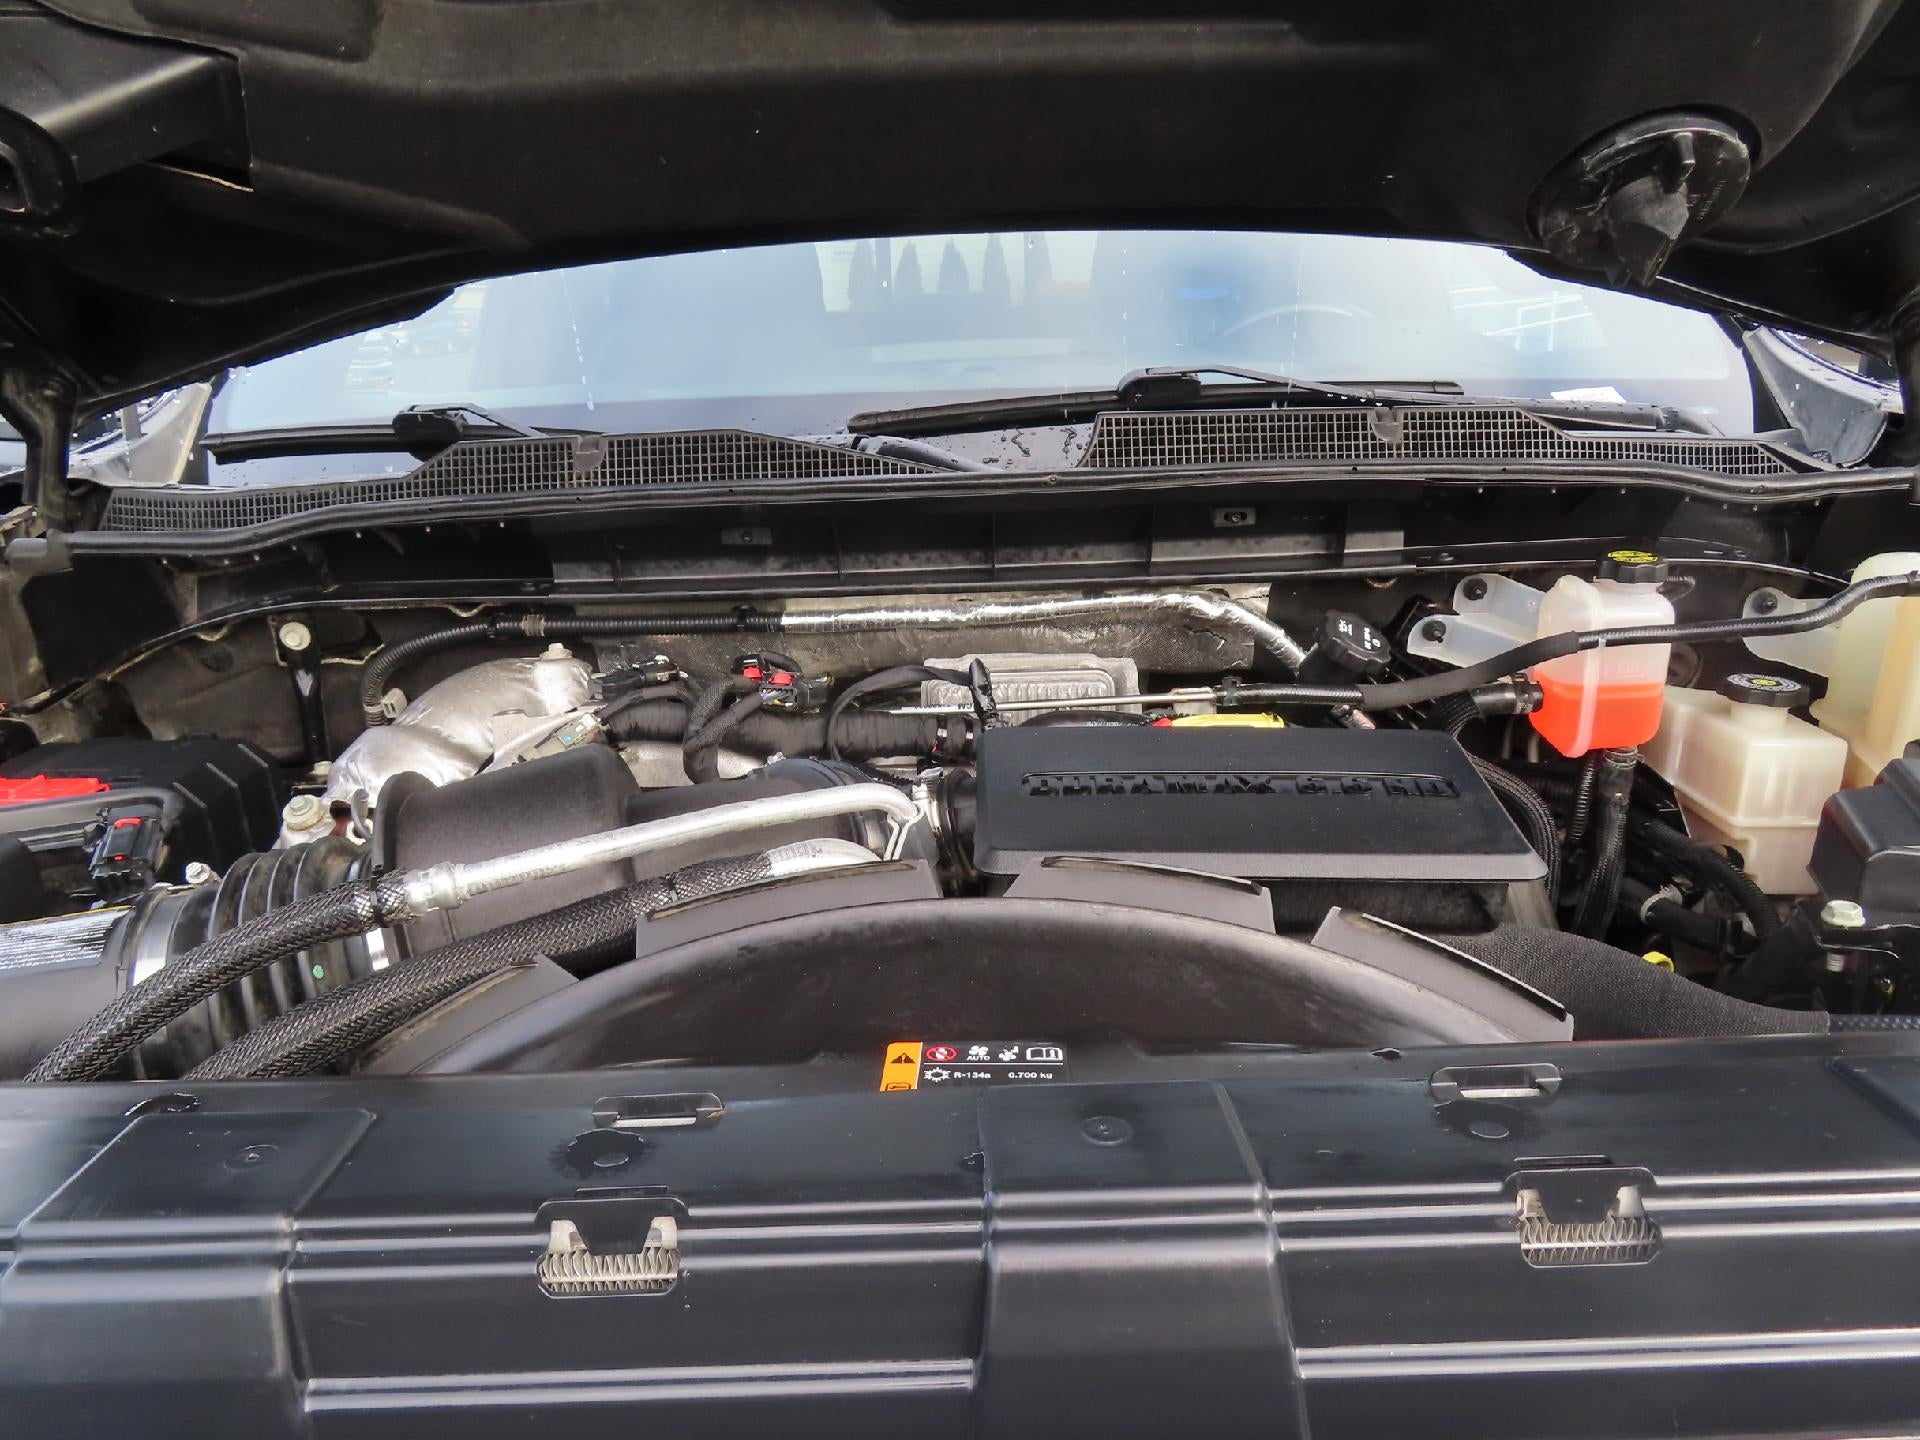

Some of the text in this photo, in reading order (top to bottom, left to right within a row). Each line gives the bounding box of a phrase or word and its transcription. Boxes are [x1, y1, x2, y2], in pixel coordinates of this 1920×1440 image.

[1028, 774, 1279, 796] DURAMAX
[1382, 778, 1461, 799] HD
[953, 1071, 991, 1079] R-134a
[1040, 1071, 1053, 1080] kg
